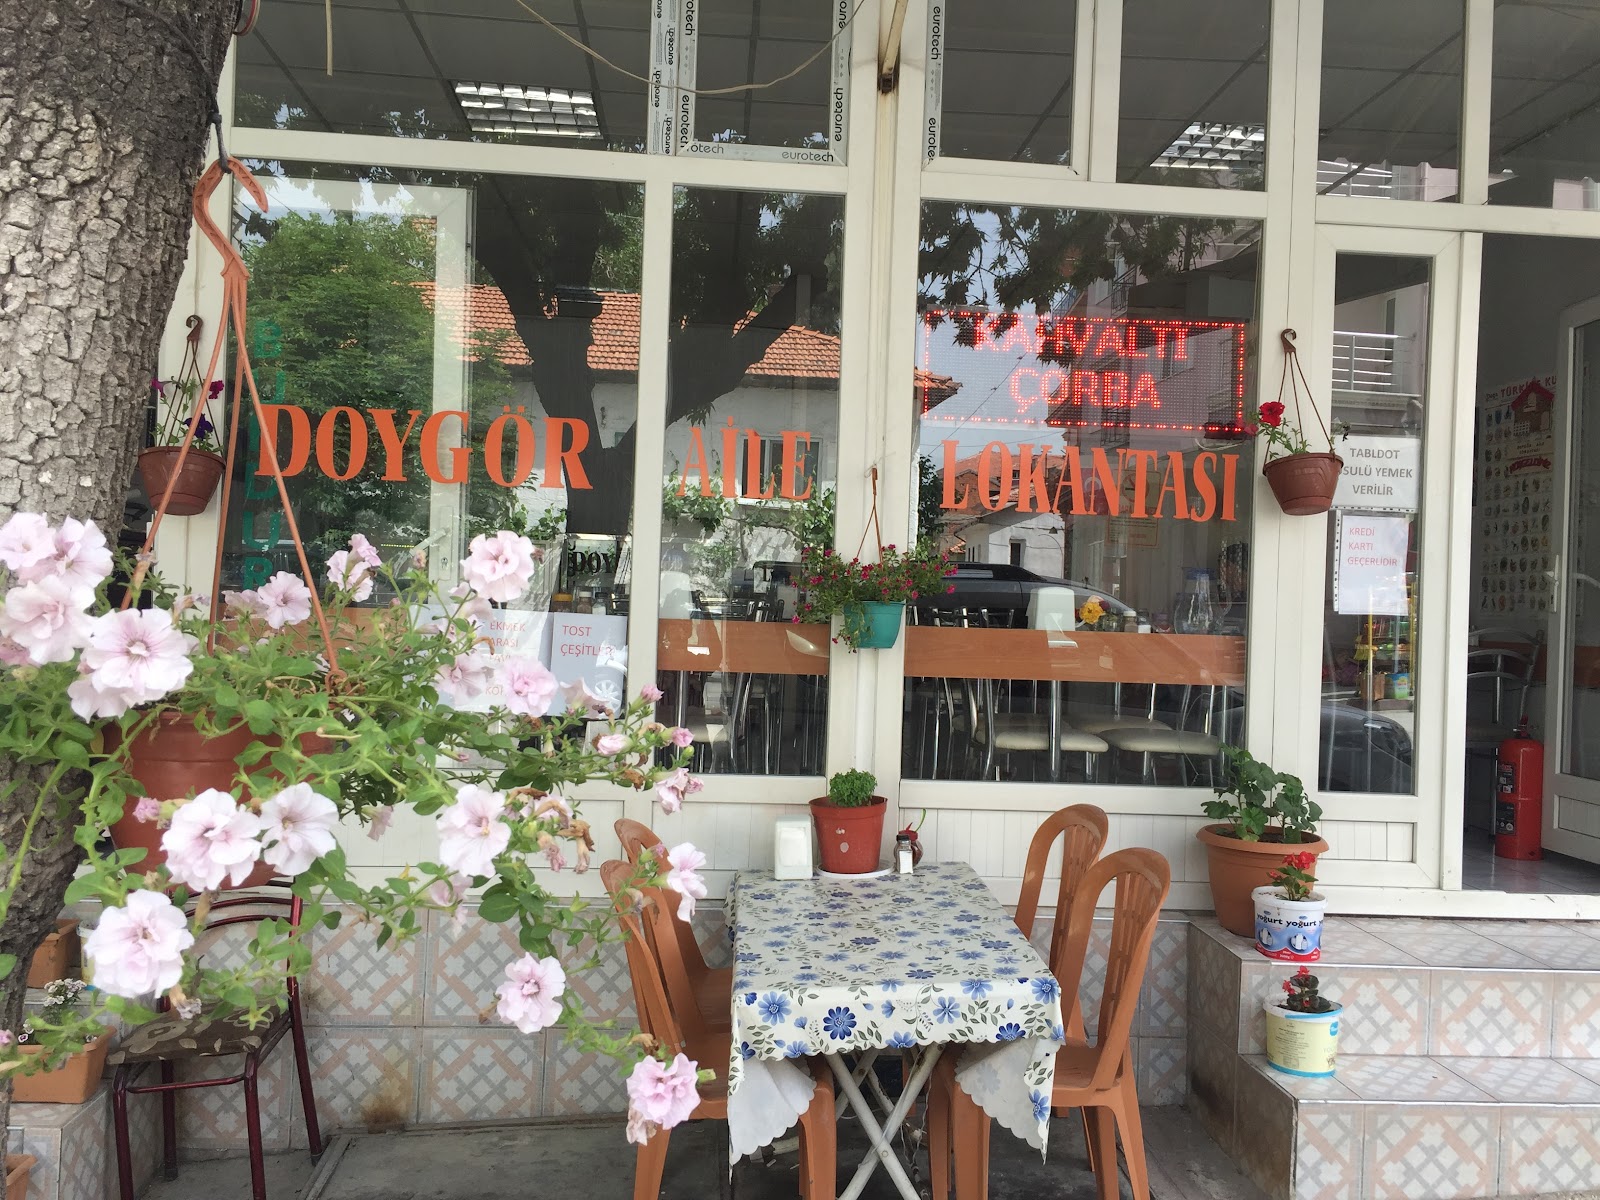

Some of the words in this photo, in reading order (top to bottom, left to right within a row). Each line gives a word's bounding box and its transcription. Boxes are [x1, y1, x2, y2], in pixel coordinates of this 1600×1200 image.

[931, 6, 941, 60] eurotech
[667, 27, 675, 65] eurotech
[834, 87, 843, 142] eurotech
[664, 117, 672, 155] eurotech
[782, 151, 833, 163] eurotech
[973, 314, 1188, 359] KAHVALTI
[1009, 368, 1161, 414] ÇORBA
[1350, 448, 1400, 459] TABLDOT
[254, 403, 593, 489] DOYGÖR
[676, 416, 813, 500] AİLE
[940, 440, 1239, 521] LOKANTASI
[1343, 465, 1372, 477] SULÜ
[1375, 467, 1413, 478] YEMEK
[1352, 484, 1393, 495] VERİLİR
[1349, 527, 1375, 537] KREDİ
[1348, 542, 1373, 551] KARTI
[490, 621, 526, 632] EKMEK
[562, 625, 592, 637] TOST
